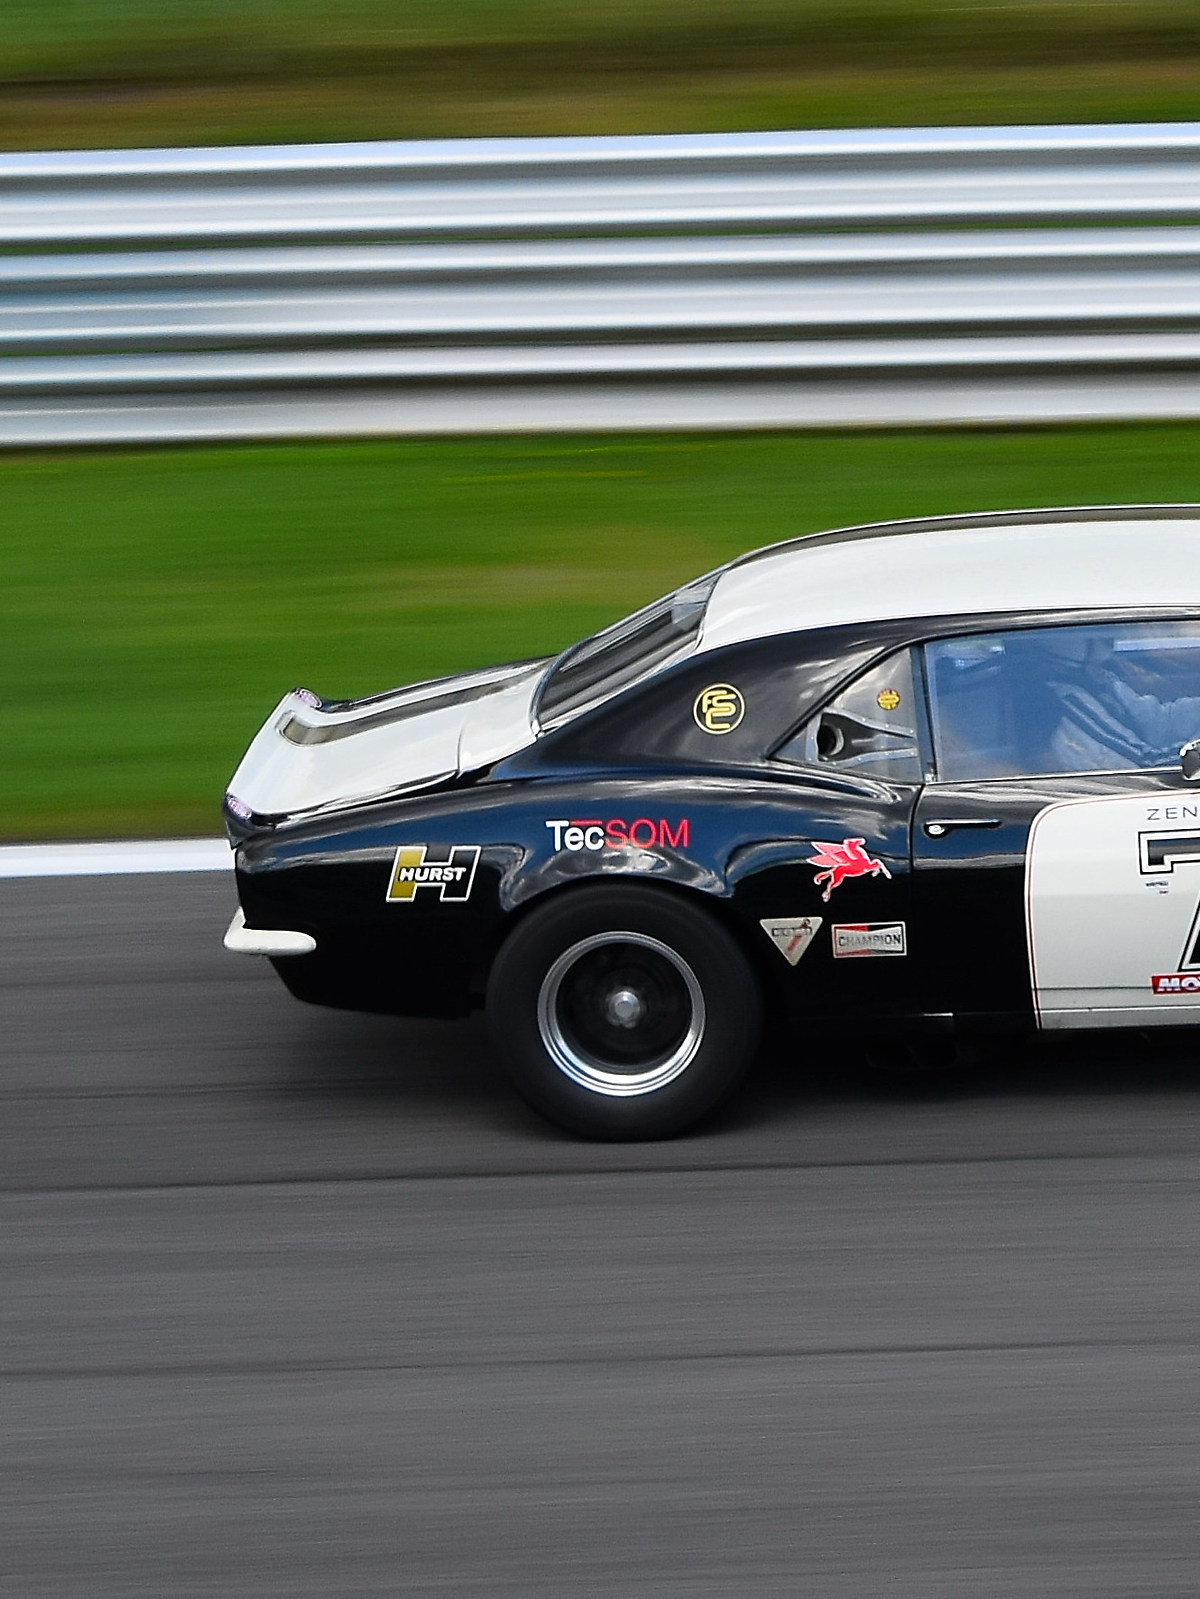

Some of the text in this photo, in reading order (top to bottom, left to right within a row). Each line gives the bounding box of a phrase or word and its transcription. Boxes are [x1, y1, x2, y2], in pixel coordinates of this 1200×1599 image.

[546, 818, 689, 851] TecSOM
[399, 866, 466, 882] HURST
[838, 934, 902, 947] CHAMPION
